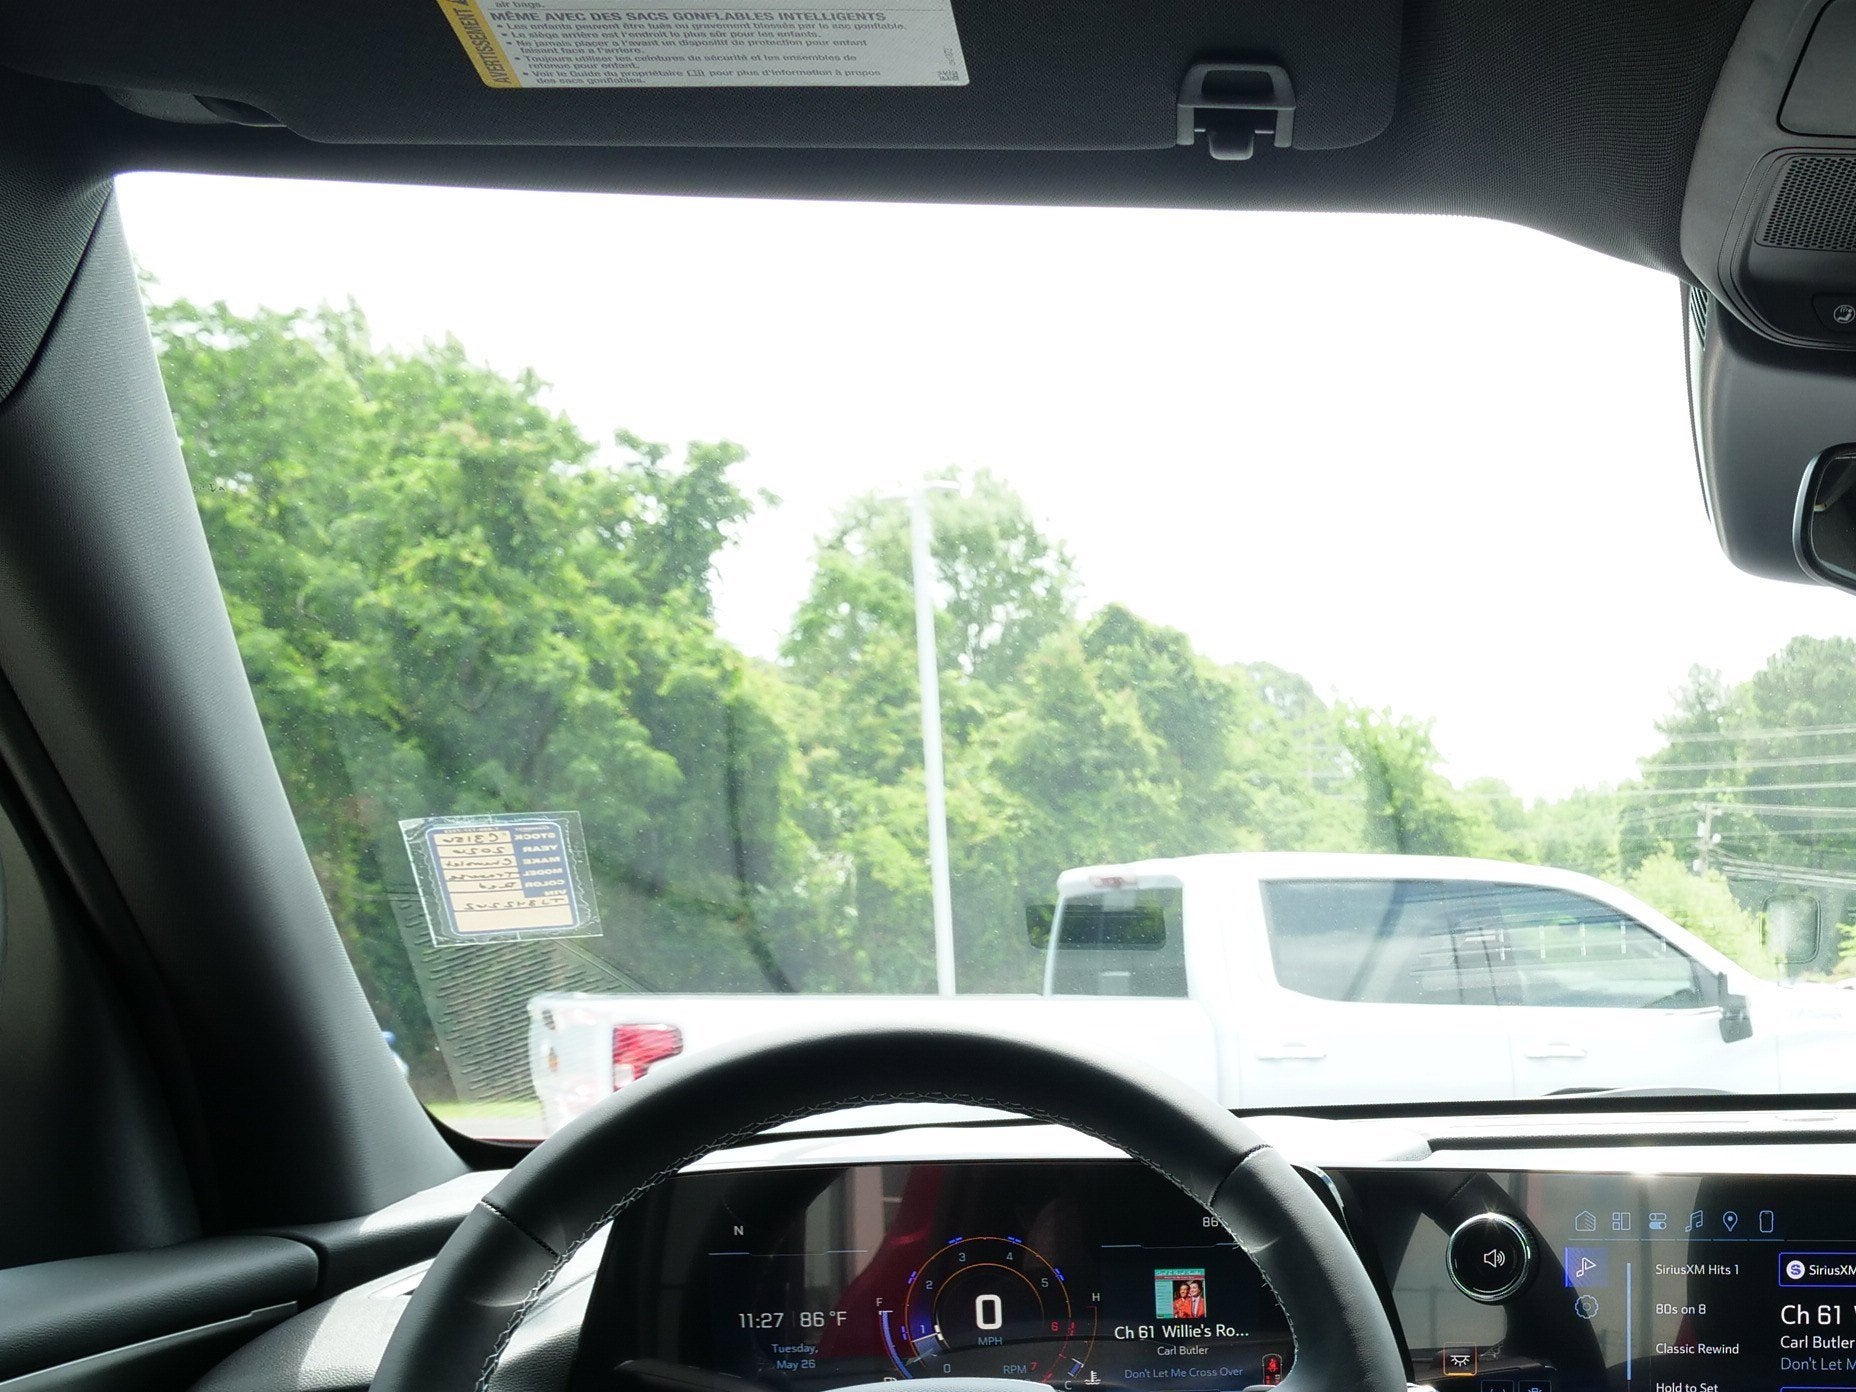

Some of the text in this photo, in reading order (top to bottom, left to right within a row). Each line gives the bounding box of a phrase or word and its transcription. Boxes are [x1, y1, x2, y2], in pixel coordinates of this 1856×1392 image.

[491, 11, 886, 22] MÊME AVEC DES SACS GONFLABLES INTELLIGENTS
[734, 1226, 744, 1235] N
[959, 1253, 966, 1262] 3
[1006, 1252, 1014, 1261] 4
[1656, 1264, 1739, 1275] SiriusXM Hits 1
[926, 1281, 934, 1290] 2
[1042, 1278, 1049, 1288] 5
[876, 1298, 883, 1307] F
[1092, 1293, 1100, 1302] H
[976, 1294, 1003, 1330] 0
[1656, 1304, 1706, 1315] 80s on 8
[739, 1312, 784, 1328] 11:27
[800, 1312, 825, 1328] 86
[1780, 1305, 1810, 1326] Ch
[1818, 1305, 1842, 1325] 61
[1051, 1322, 1059, 1331] 6
[1114, 1327, 1134, 1339] Ch
[1139, 1326, 1154, 1338] 61
[1162, 1324, 1212, 1338] Willie's
[978, 1336, 1003, 1346] MPH
[1780, 1336, 1856, 1349] Carl Butler
[772, 1344, 818, 1354] Tuesday,
[1158, 1345, 1209, 1356] Carl Butler
[1656, 1343, 1739, 1354] Classic Rewind
[776, 1360, 816, 1371] May 26
[944, 1364, 951, 1373] 0
[1003, 1364, 1027, 1374] RPM
[1030, 1362, 1038, 1371] 7
[1780, 1358, 1817, 1371] Don't
[1820, 1358, 1842, 1371] Let
[1124, 1367, 1244, 1378] Don't Let Me Cross Over
[1064, 1380, 1072, 1390] C
